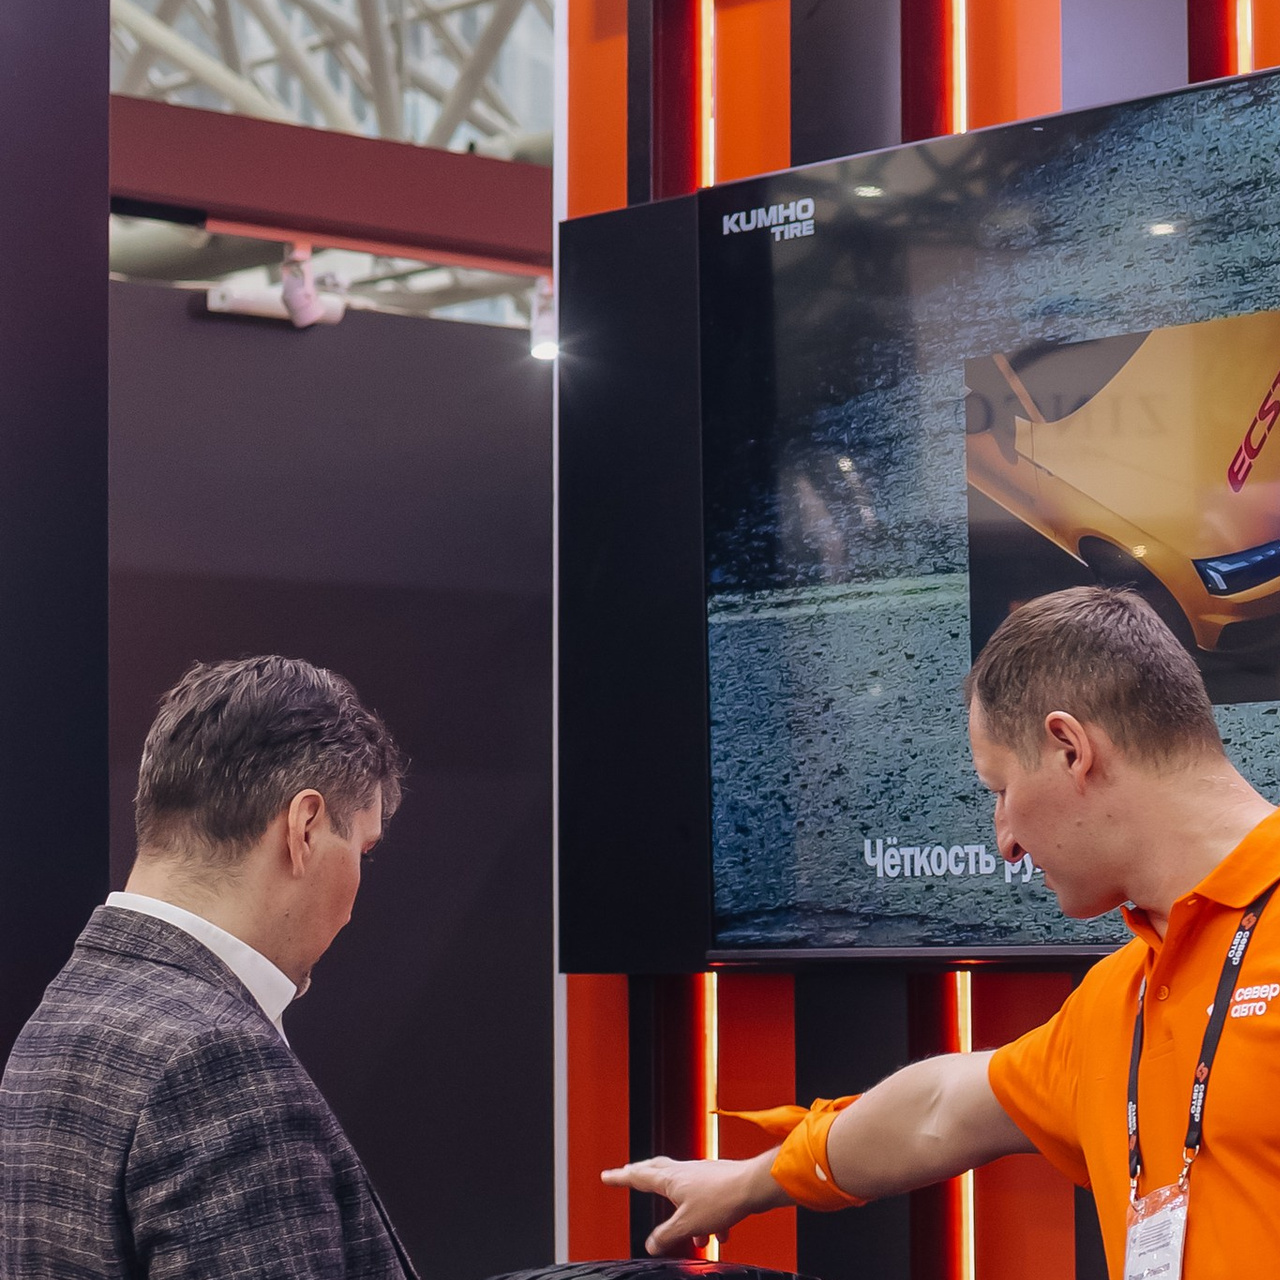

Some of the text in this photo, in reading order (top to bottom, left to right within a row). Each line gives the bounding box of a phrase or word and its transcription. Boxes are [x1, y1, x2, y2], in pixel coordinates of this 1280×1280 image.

[722, 197, 815, 236] KUMHO
[770, 219, 815, 242] TIRE
[863, 836, 996, 878] Чёткость
[1234, 983, 1280, 1002] север
[1230, 1001, 1267, 1018] авто
